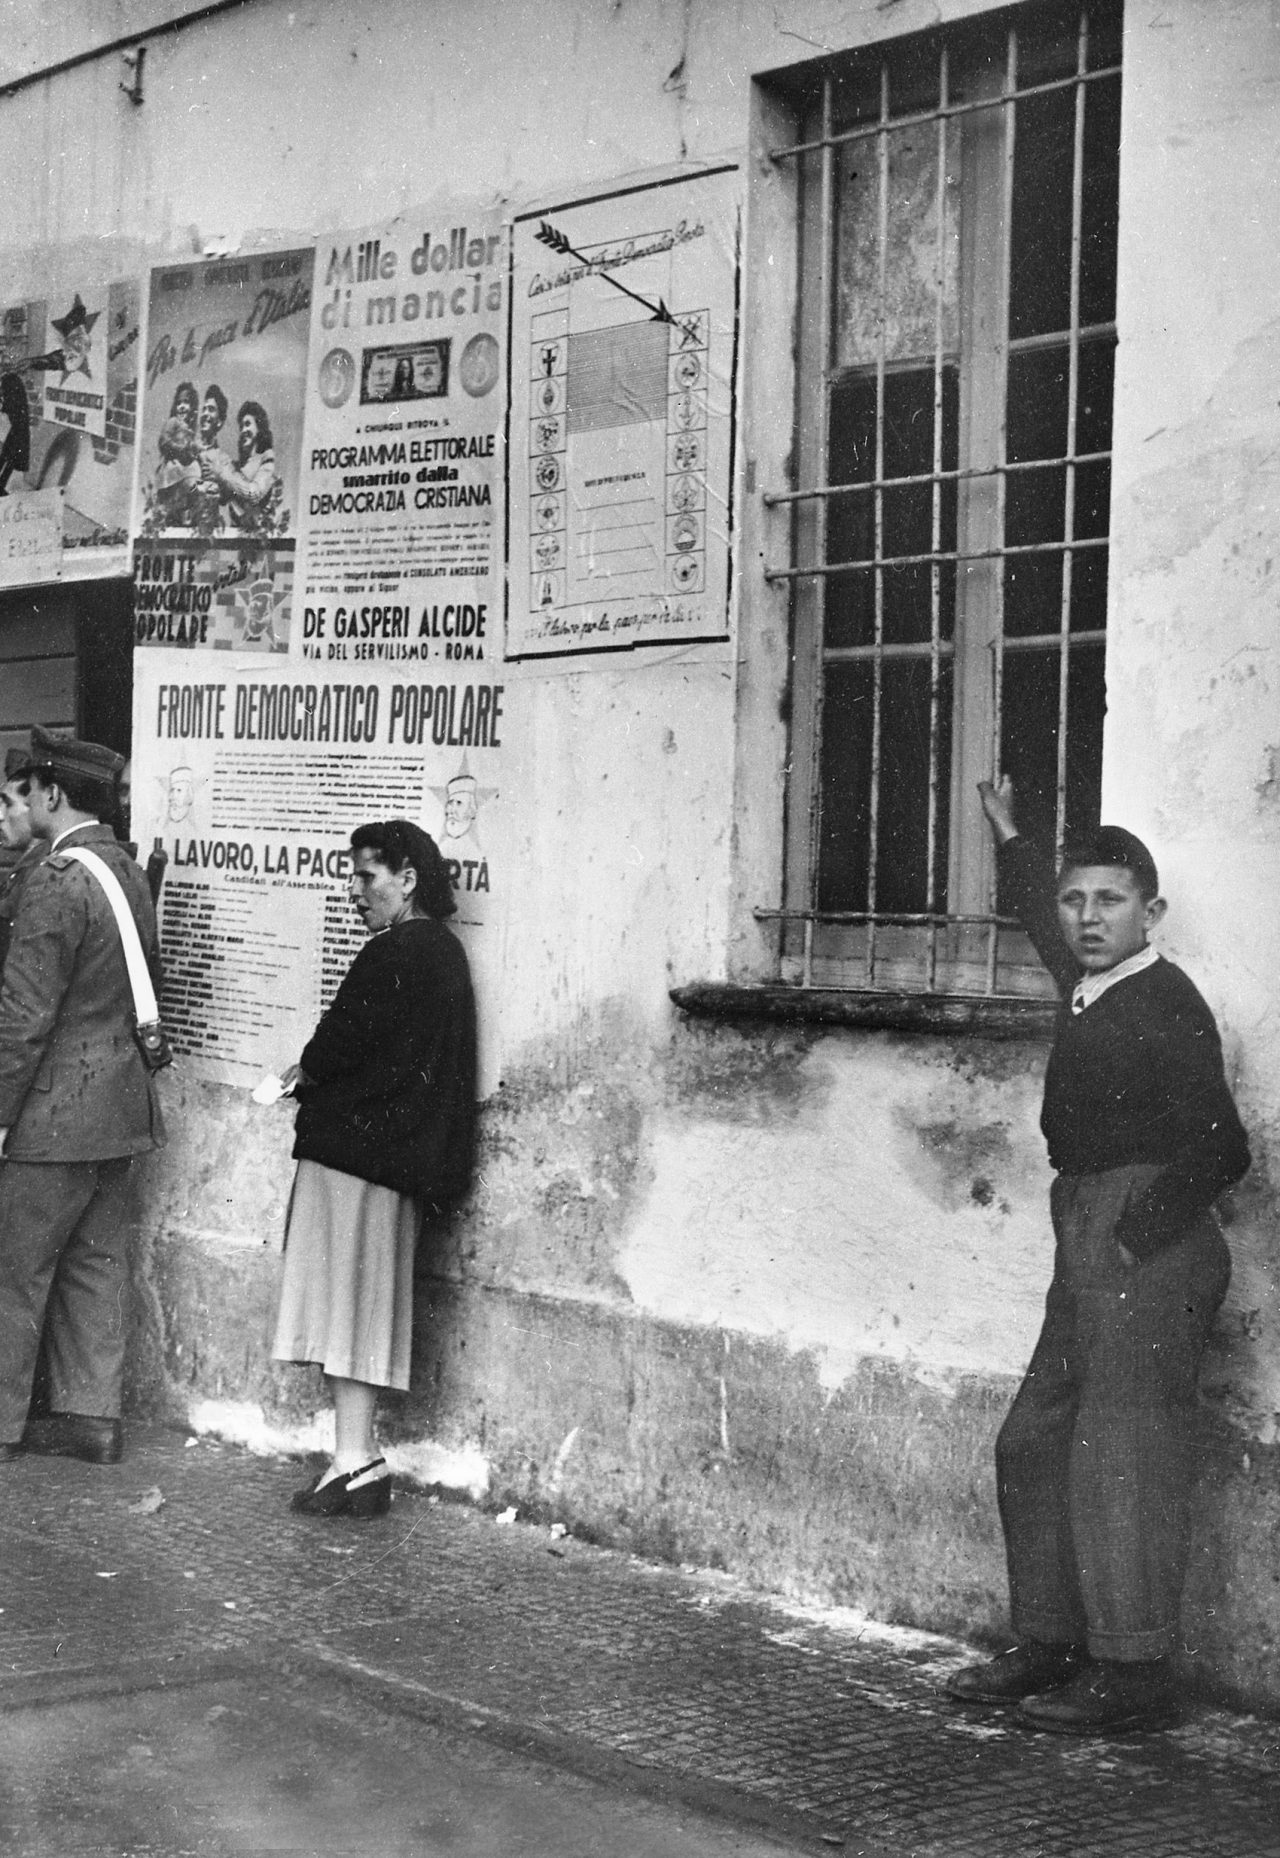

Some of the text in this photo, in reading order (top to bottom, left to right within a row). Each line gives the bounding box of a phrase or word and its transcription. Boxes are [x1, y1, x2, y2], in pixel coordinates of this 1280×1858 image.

[325, 239, 398, 286] Mille
[321, 272, 502, 330] di mancia
[311, 434, 495, 470] PROGRAMMA ELETTORALE
[342, 466, 459, 489] smarrito dalla
[309, 484, 492, 516] DEMOCRAZIA CRISTIANA
[134, 554, 195, 583] FRONTE
[136, 614, 208, 643] OPOLARE
[303, 604, 487, 639] DE GASPERI ALCIDE
[303, 644, 321, 660] VIA
[328, 643, 348, 660] DEL
[354, 642, 429, 661] SERVILISMO
[445, 642, 484, 661] ROMA
[157, 684, 504, 747] FRONTE DEMOCRATICO POPOLARE
[174, 838, 490, 892] LAVORO, LA PACE, RTÀ
[224, 874, 266, 886] Candidati
[332, 948, 359, 956] GIUSEPP
